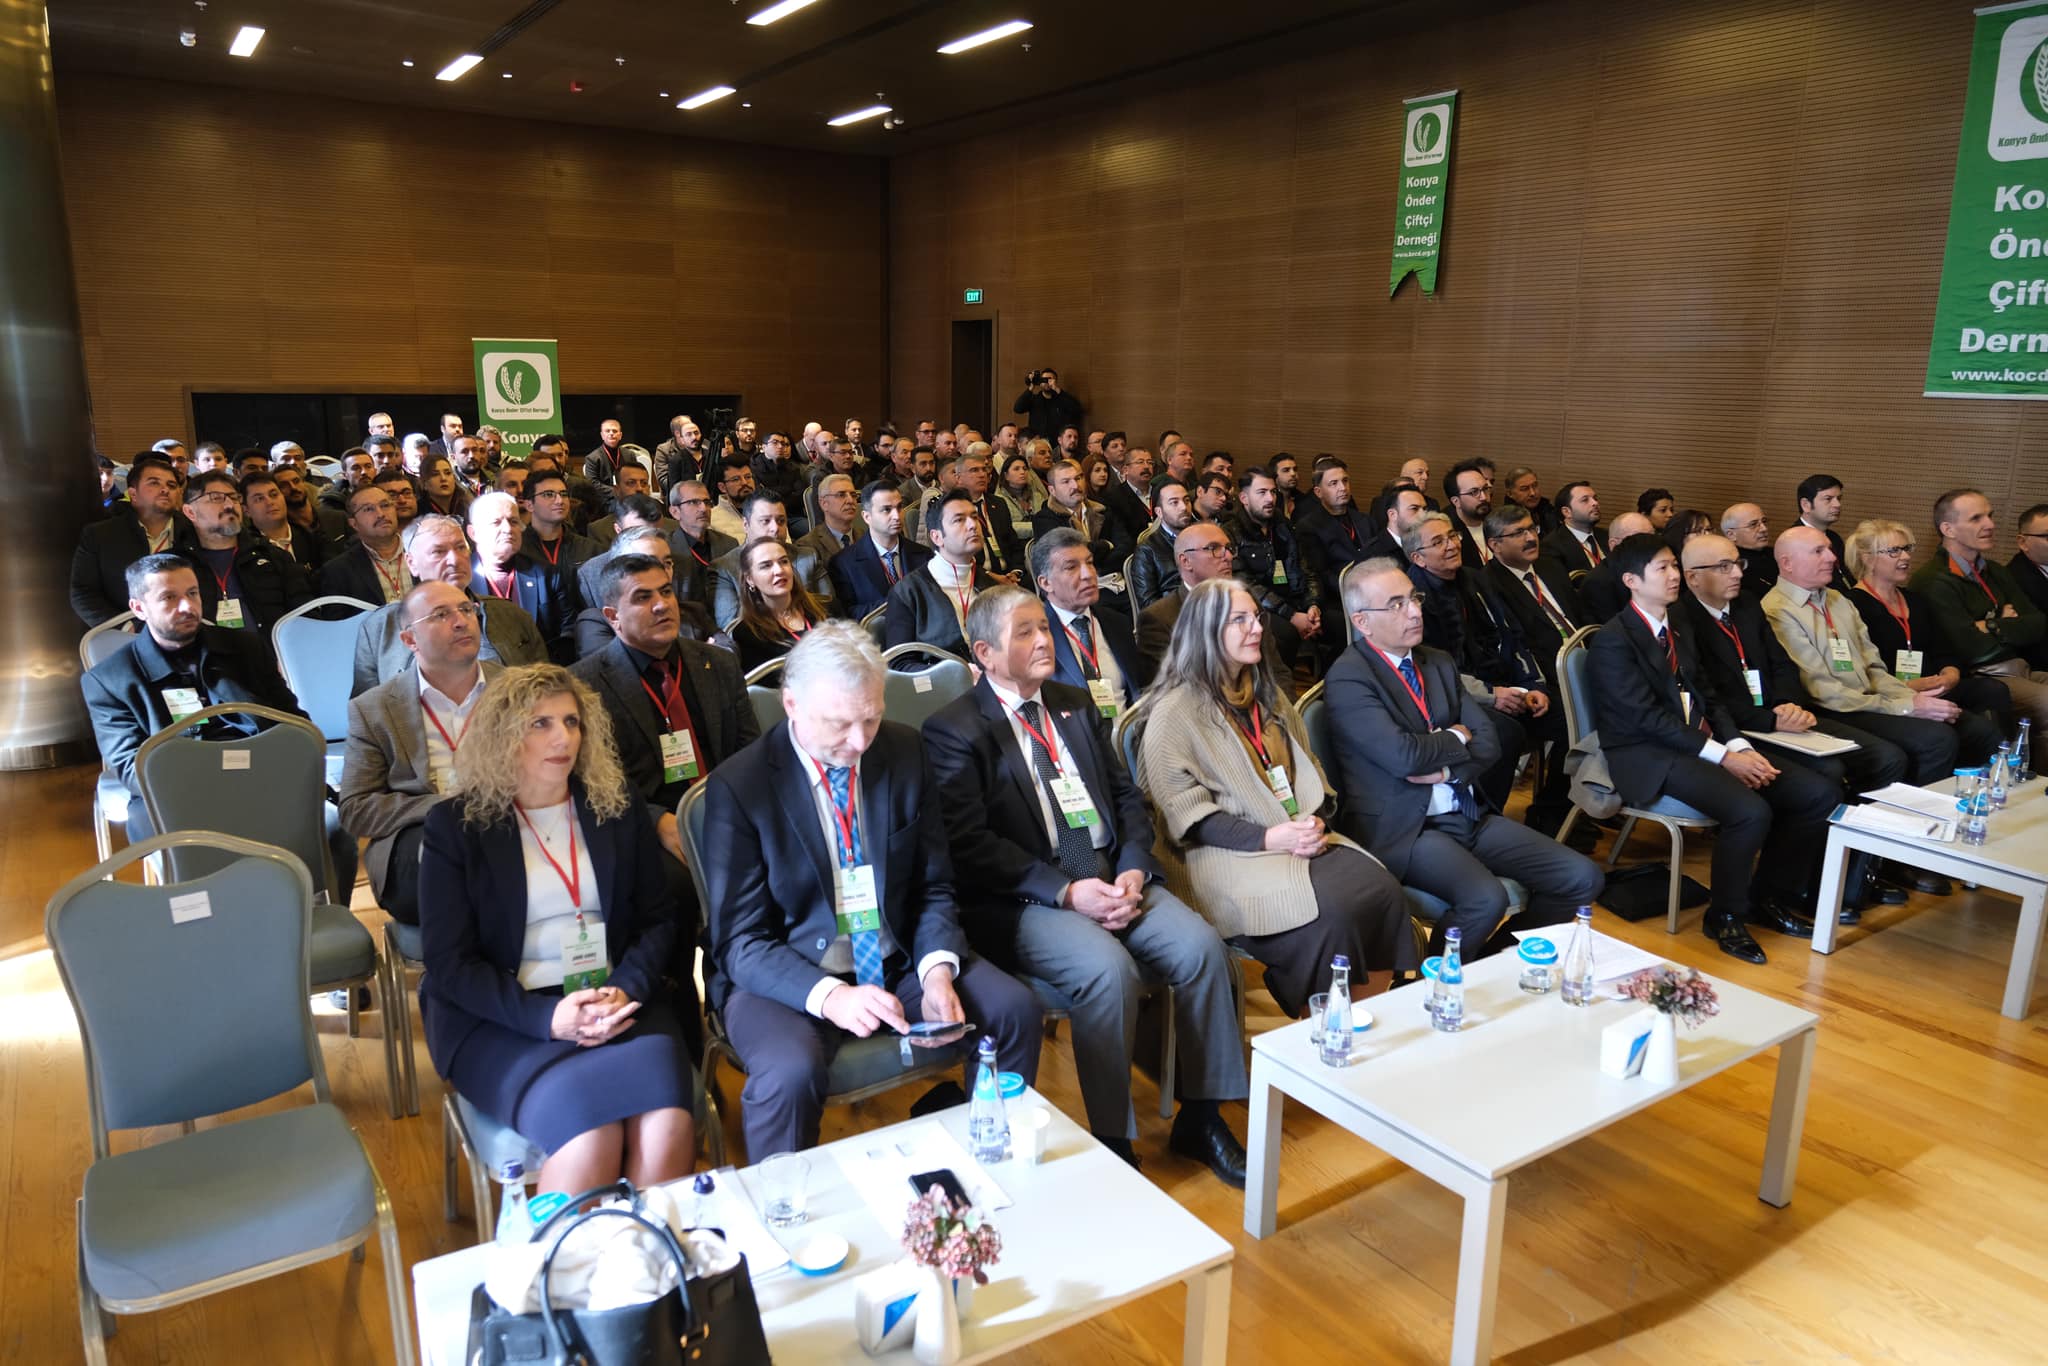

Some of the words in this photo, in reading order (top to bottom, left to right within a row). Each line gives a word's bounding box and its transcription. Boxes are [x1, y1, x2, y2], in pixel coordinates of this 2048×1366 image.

[1998, 136, 2028, 147] Konya
[1406, 176, 1438, 189] Konya
[1405, 194, 1437, 207] Önder
[1994, 184, 2048, 212] Ko
[1405, 213, 1433, 230] Çiftçi
[1397, 232, 1437, 246] Derneği
[1990, 227, 2048, 260] Ön
[967, 292, 979, 301] EXIT
[1960, 327, 2048, 353] Dern
[1951, 368, 2048, 382] www.kocd
